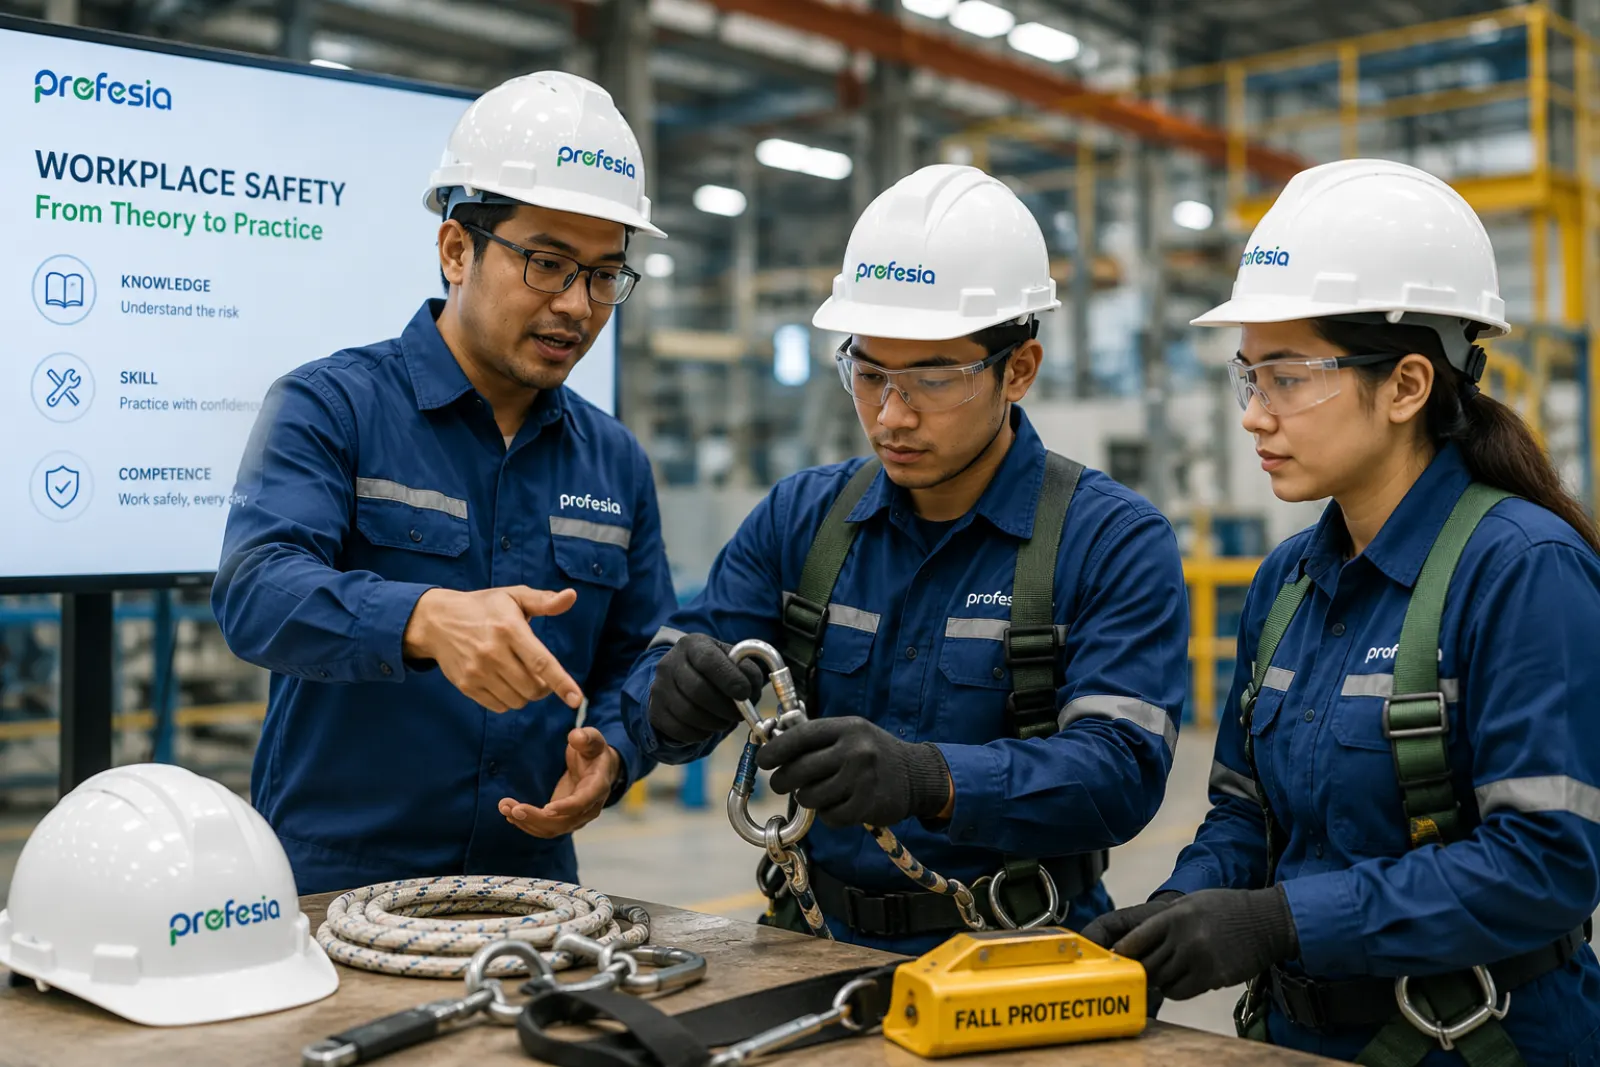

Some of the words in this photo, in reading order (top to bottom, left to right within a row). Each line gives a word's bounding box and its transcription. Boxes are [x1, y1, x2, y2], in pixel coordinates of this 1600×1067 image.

[34, 69, 172, 110] profesia
[556, 146, 635, 179] profesia
[35, 149, 236, 197] WORKPLACE
[244, 172, 346, 206] SAFETY
[35, 194, 102, 223] From
[110, 200, 196, 236] Theory
[203, 213, 227, 233] to
[234, 212, 324, 240] Practice
[121, 274, 211, 293] KNOWLEDGE
[855, 261, 936, 285] profesia
[121, 301, 193, 317] Understand
[196, 303, 216, 317] the
[218, 304, 240, 319] risk
[120, 371, 158, 386] SKILL
[119, 396, 169, 410] Practice
[172, 397, 198, 410] with
[118, 467, 212, 481] COMPETENCE
[118, 493, 150, 506] Work
[153, 491, 191, 508] safely,
[194, 494, 226, 508] every
[559, 493, 622, 515] profesia
[169, 895, 281, 947] profesia
[955, 1009, 1002, 1030] FALL
[1008, 995, 1130, 1025] PROTECTION
